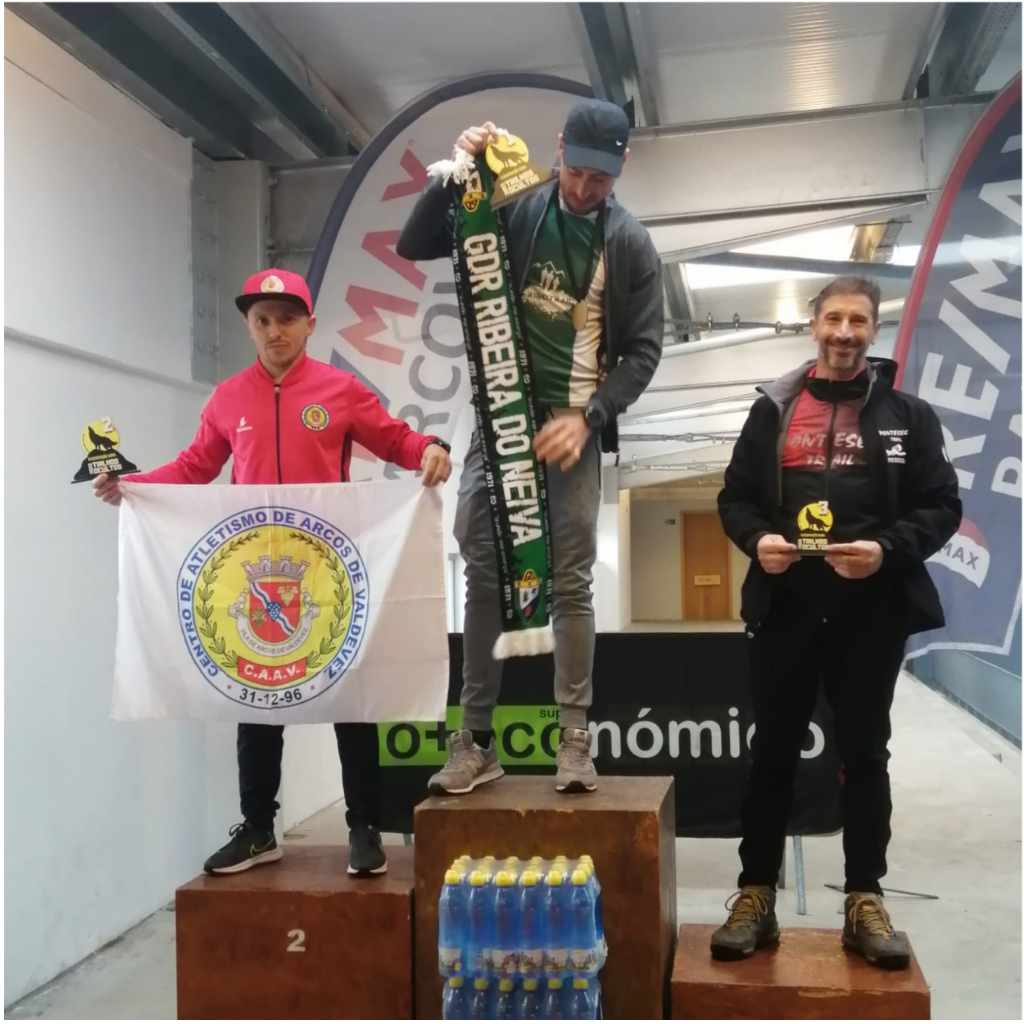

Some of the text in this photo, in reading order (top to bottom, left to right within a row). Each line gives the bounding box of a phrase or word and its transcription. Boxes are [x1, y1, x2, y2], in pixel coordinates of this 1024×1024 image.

[464, 232, 543, 548] GDR RIBEIRA DO NEIVA
[273, 510, 296, 525] DE
[186, 511, 267, 576] ATLETISMO
[300, 517, 352, 559] ARCOS
[347, 559, 364, 584] DE
[180, 579, 193, 601] DE
[181, 610, 218, 677] CENTRO
[324, 588, 367, 679] VALDEVEZ
[243, 663, 301, 681] C.A.A.V.
[239, 688, 302, 705] 31-12-96
[286, 929, 306, 952] 2
